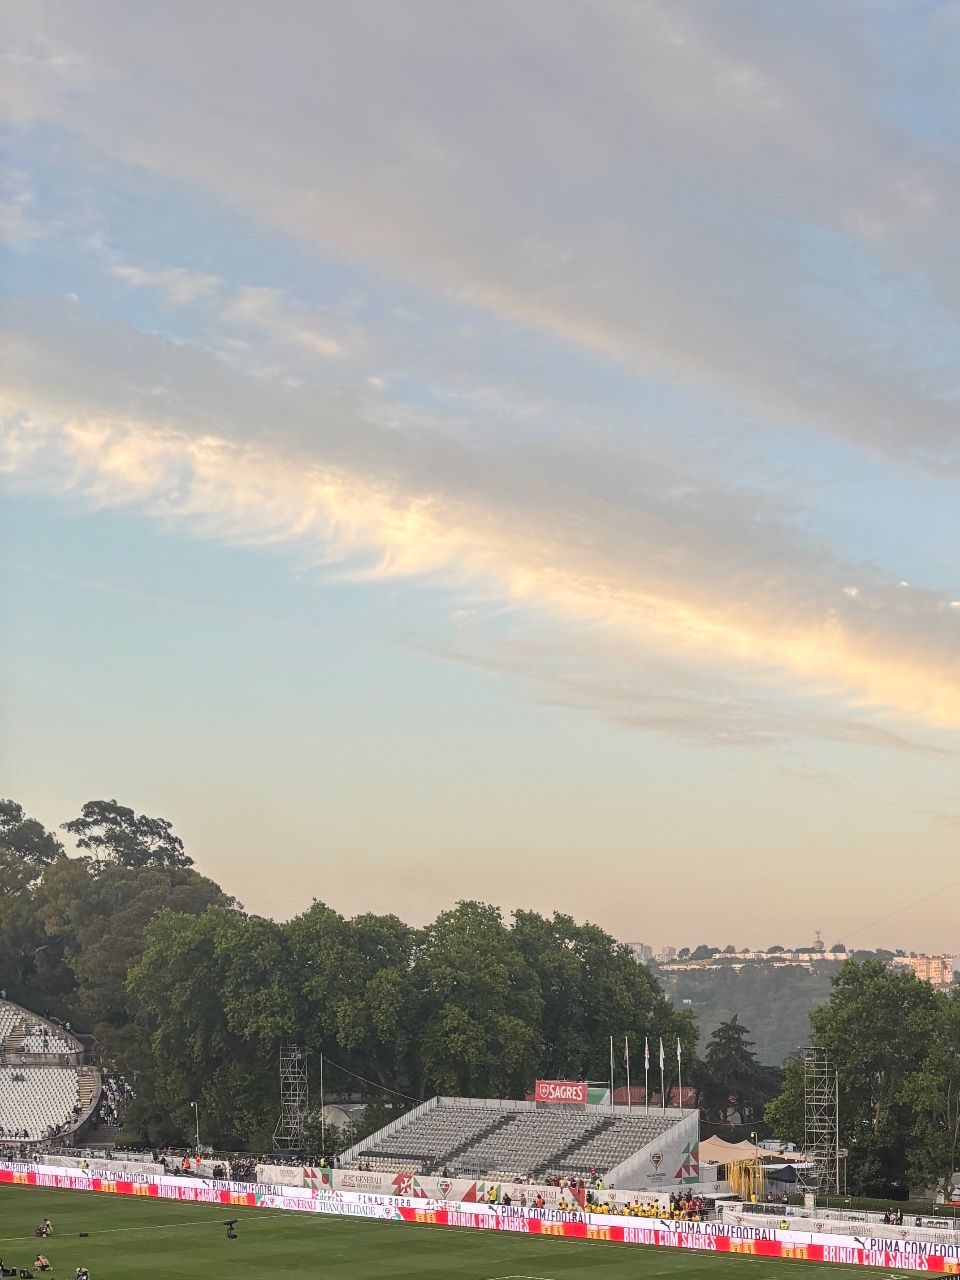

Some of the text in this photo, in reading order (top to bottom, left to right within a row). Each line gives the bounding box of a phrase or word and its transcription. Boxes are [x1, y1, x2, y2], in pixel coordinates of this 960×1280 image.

[549, 1084, 583, 1101] SAGRES
[283, 1198, 376, 1216] GENERALI TRANQUILIDADE
[448, 1211, 530, 1233] BRINDA COM SAGRES
[674, 1220, 777, 1241] PUMA.COM/FOOTBALL
[623, 1227, 718, 1250] BRINDA COM SAGRES
[823, 1245, 929, 1271] BRINDA COM SAGRES
